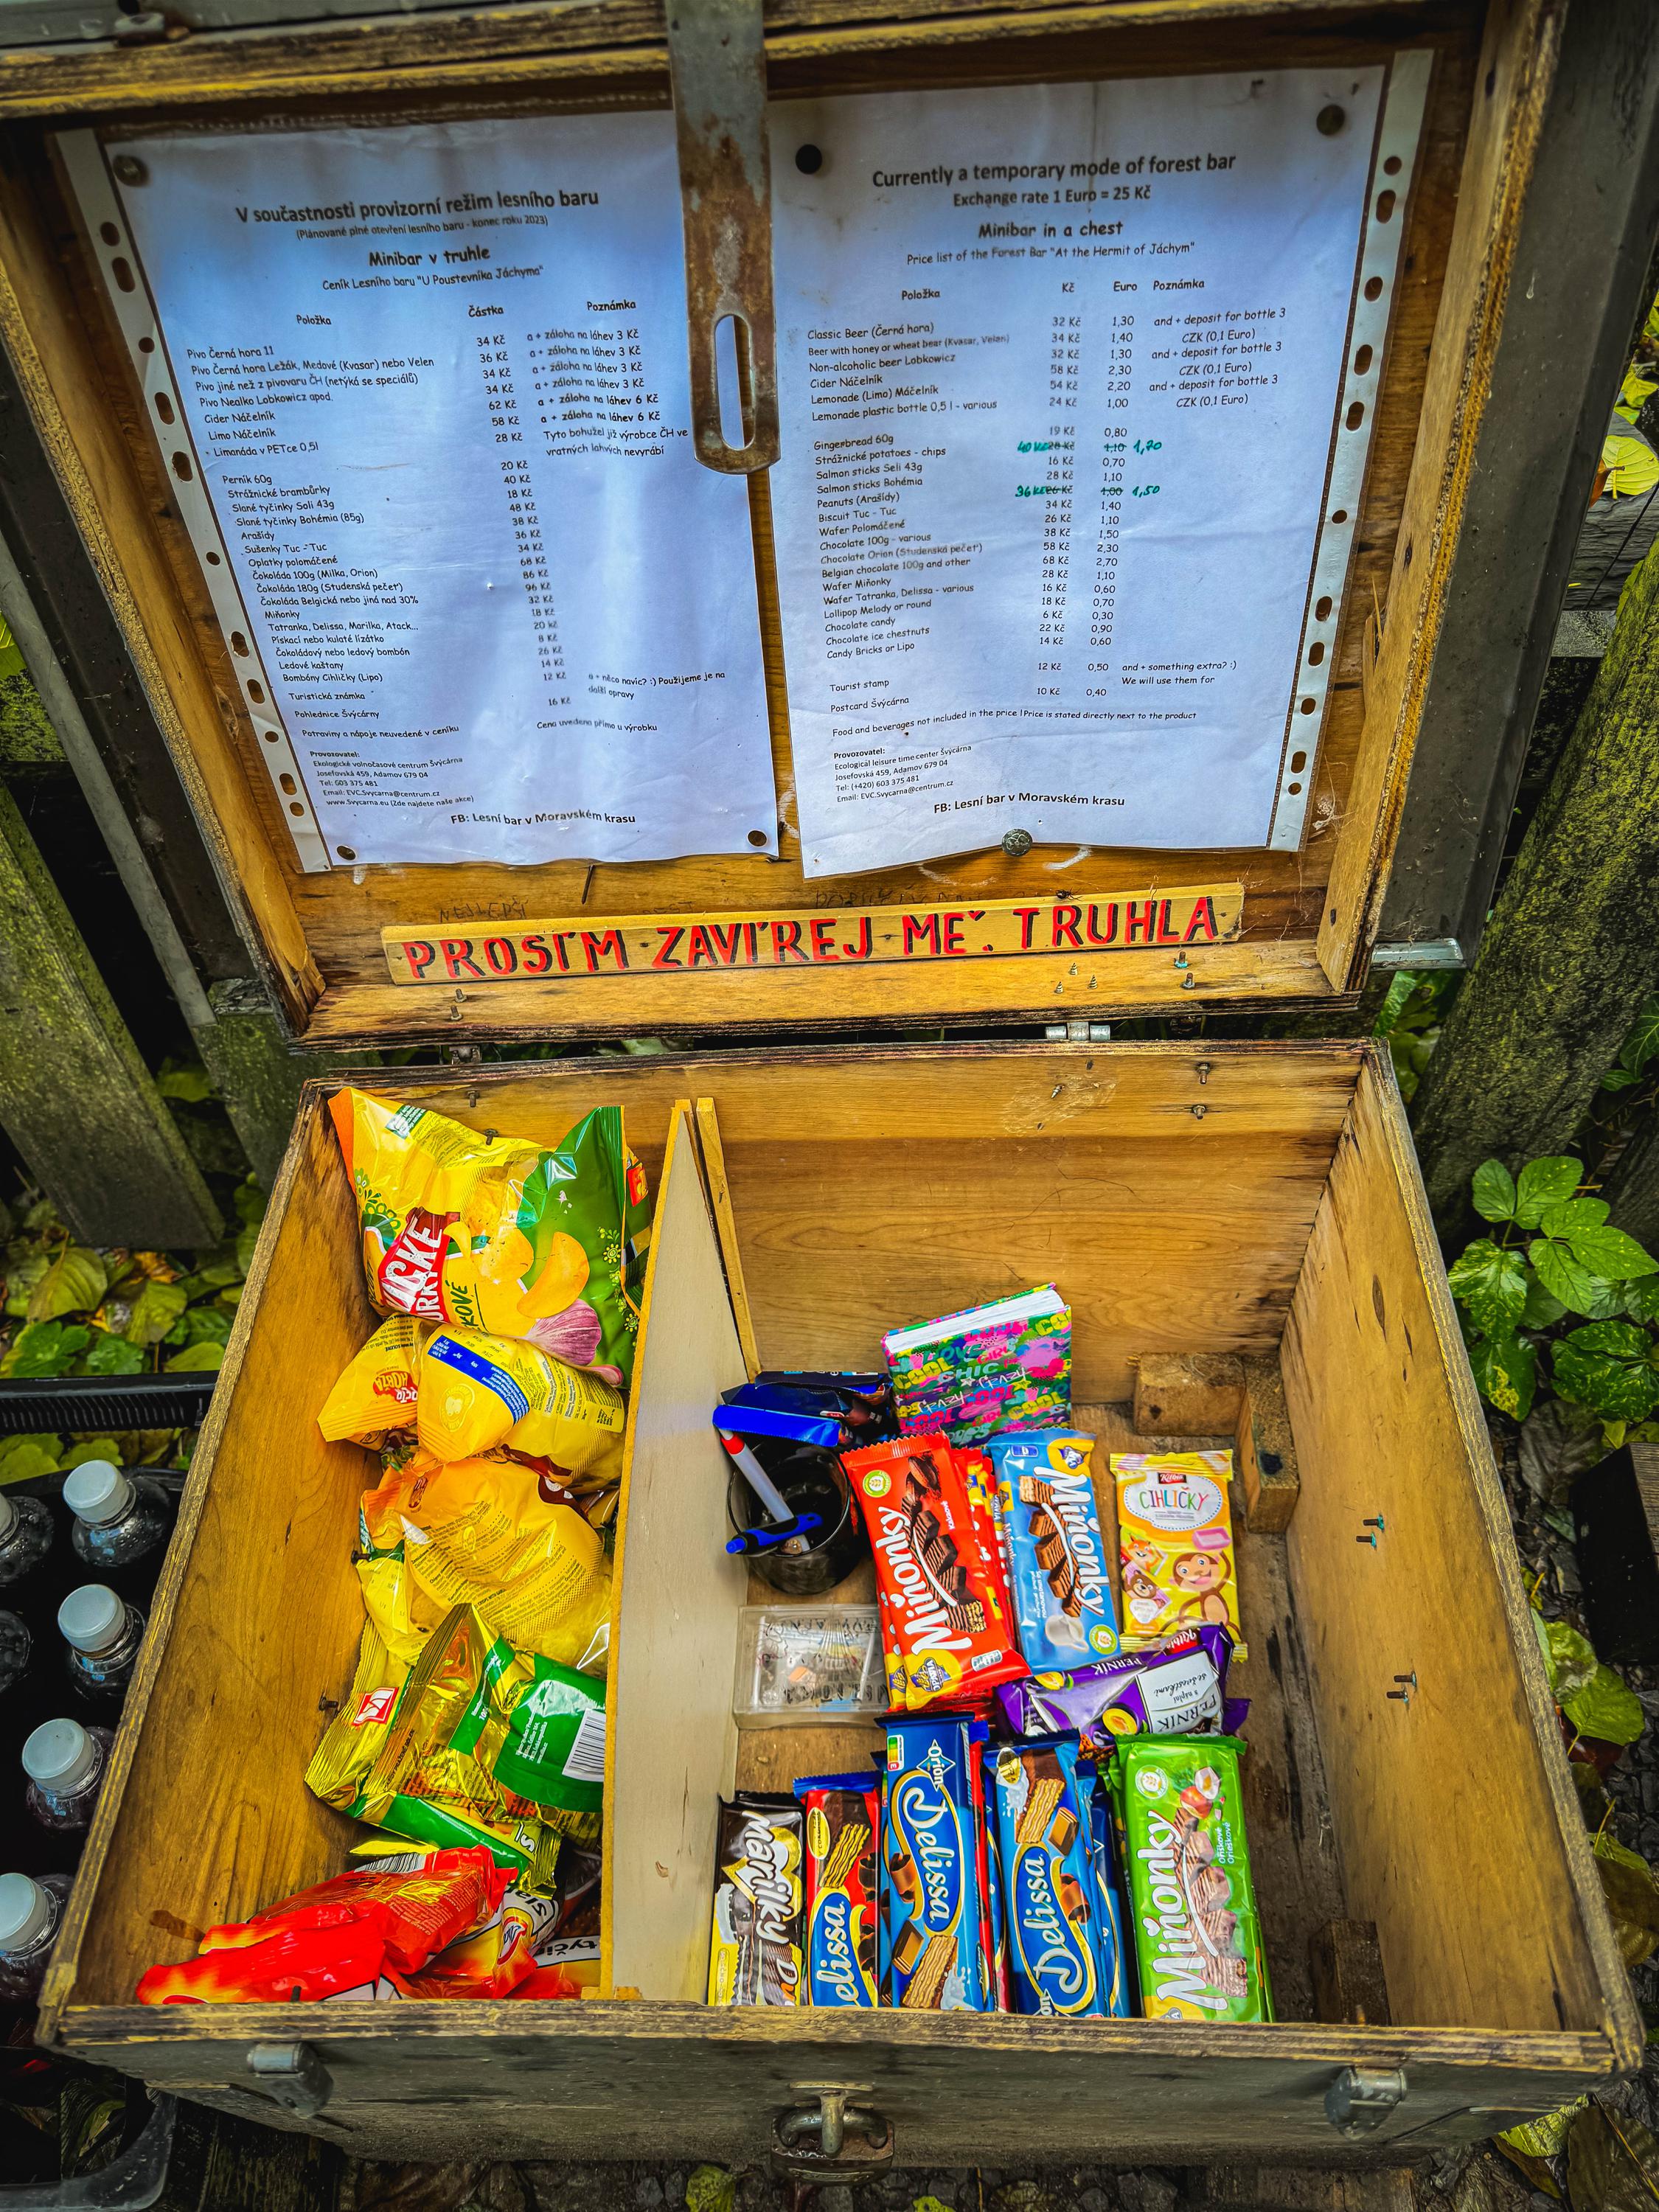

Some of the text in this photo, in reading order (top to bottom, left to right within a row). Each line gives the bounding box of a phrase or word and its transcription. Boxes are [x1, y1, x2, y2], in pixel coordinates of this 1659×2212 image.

[872, 153, 1237, 188] Currently a temporary mode of forest bar
[953, 184, 1151, 209] Exchange rate 1 Euro = 25 Kč
[234, 189, 599, 225] V součastnosti provizorní režim lesního baru
[978, 220, 1124, 239] Minibar in a chest
[369, 244, 491, 267] Minibar v truhle
[322, 278, 351, 291] Ceník
[351, 276, 392, 289] Lesního
[392, 276, 416, 287] baru
[432, 269, 493, 285] Poustevníka
[1062, 282, 1075, 293] Kč
[1113, 281, 1138, 292] Euro
[1152, 278, 1205, 291] Poznámka
[901, 288, 941, 301] Položka
[468, 305, 504, 318] Částka
[586, 299, 636, 312] Poznámka
[296, 314, 332, 325] Položka
[1112, 315, 1135, 328] 1,30
[1153, 315, 1173, 327] and
[1183, 313, 1222, 327] deposit
[1225, 310, 1242, 323] for
[1244, 307, 1276, 321] bottle
[1279, 307, 1286, 318] 3
[807, 321, 934, 342] Classic Beer (Černá hora)
[476, 334, 506, 347] 34 Kč
[187, 345, 274, 360] Pivo Černá hora 11
[266, 444, 298, 454] PETce
[813, 433, 894, 453] Gingerbread 60g
[227, 484, 330, 499] Strážnické brambůrky
[1133, 485, 1161, 498] 1,50
[236, 512, 364, 529] Slané tyčinky Bohémia (85g)
[824, 599, 932, 619] Lollipop Melody or round
[267, 621, 419, 632] Tatranka, Delissa, Marilka, Atack...
[1039, 623, 1065, 633] 22 Kč
[1091, 624, 1113, 635] 0,90
[826, 627, 930, 646] Chocolate ice chestnuts
[276, 646, 411, 659] Čokoládový nebo ledový bombón
[321, 670, 356, 684] Cihličky
[358, 672, 383, 684] (Lipo)
[829, 680, 890, 692] Tourist stamp
[288, 692, 366, 700] Turistická známka
[830, 697, 909, 713] Postcard Švýcárna
[294, 708, 380, 720] Pohlednice Švýcárny
[933, 802, 951, 814] FB:
[954, 796, 984, 810] Lesní
[986, 794, 1006, 804] bar
[1018, 792, 1089, 804] Moravském
[1092, 795, 1125, 806] krasu
[451, 814, 470, 824] FB:
[472, 813, 501, 824] Lesní
[503, 814, 522, 826] bar
[535, 809, 602, 824] Moravském
[604, 813, 636, 824] krasu
[1013, 896, 1219, 950] TRUHLA
[1139, 1486, 1210, 1512] CIHLIČKY
[1034, 1466, 1111, 1616] Miňonky
[875, 1505, 973, 1658] Miňonky
[1091, 1658, 1143, 1676] PERNÍK
[1157, 1693, 1217, 1732] PERNÍK
[928, 1746, 945, 1786] Orion
[902, 1786, 956, 1925] Delissa
[741, 1809, 794, 1945] Marilky
[1137, 1809, 1228, 2011] Miňonky
[1023, 1854, 1084, 1994] Delissa
[816, 1900, 860, 2006] elissa
